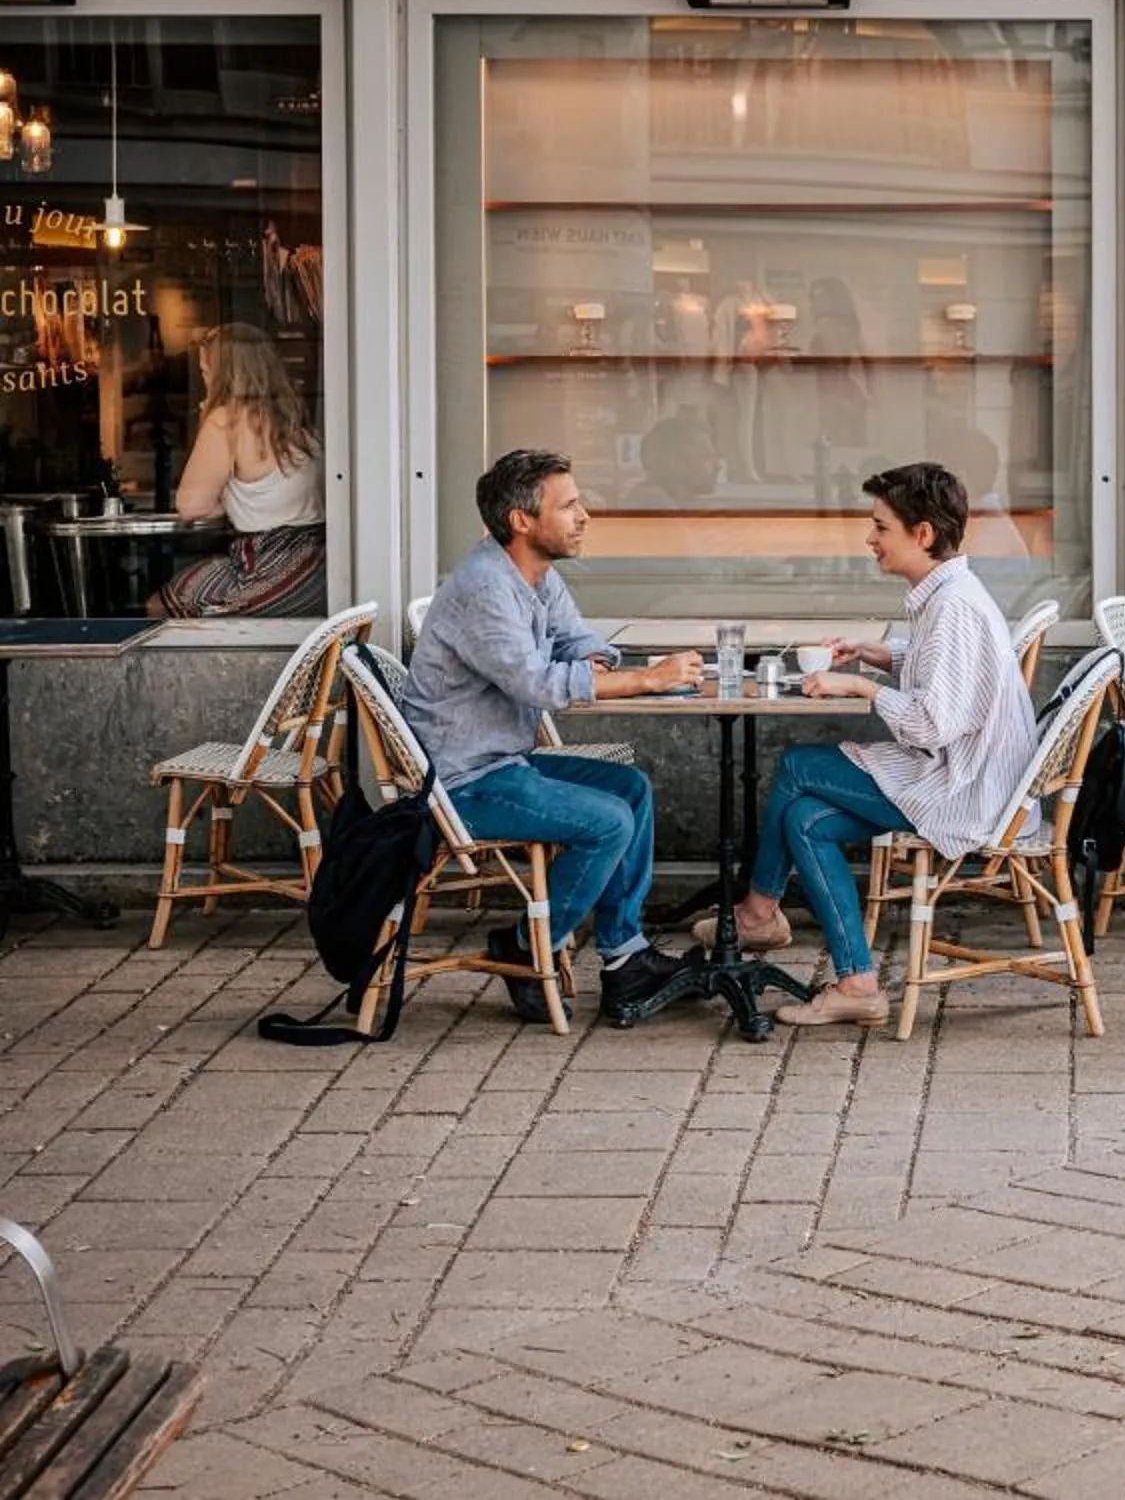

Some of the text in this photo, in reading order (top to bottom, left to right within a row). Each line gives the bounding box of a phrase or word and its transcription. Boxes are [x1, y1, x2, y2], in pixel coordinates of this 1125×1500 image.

[29, 200, 98, 241] jour
[0, 278, 148, 317] chocolat
[2, 358, 90, 393] sants
